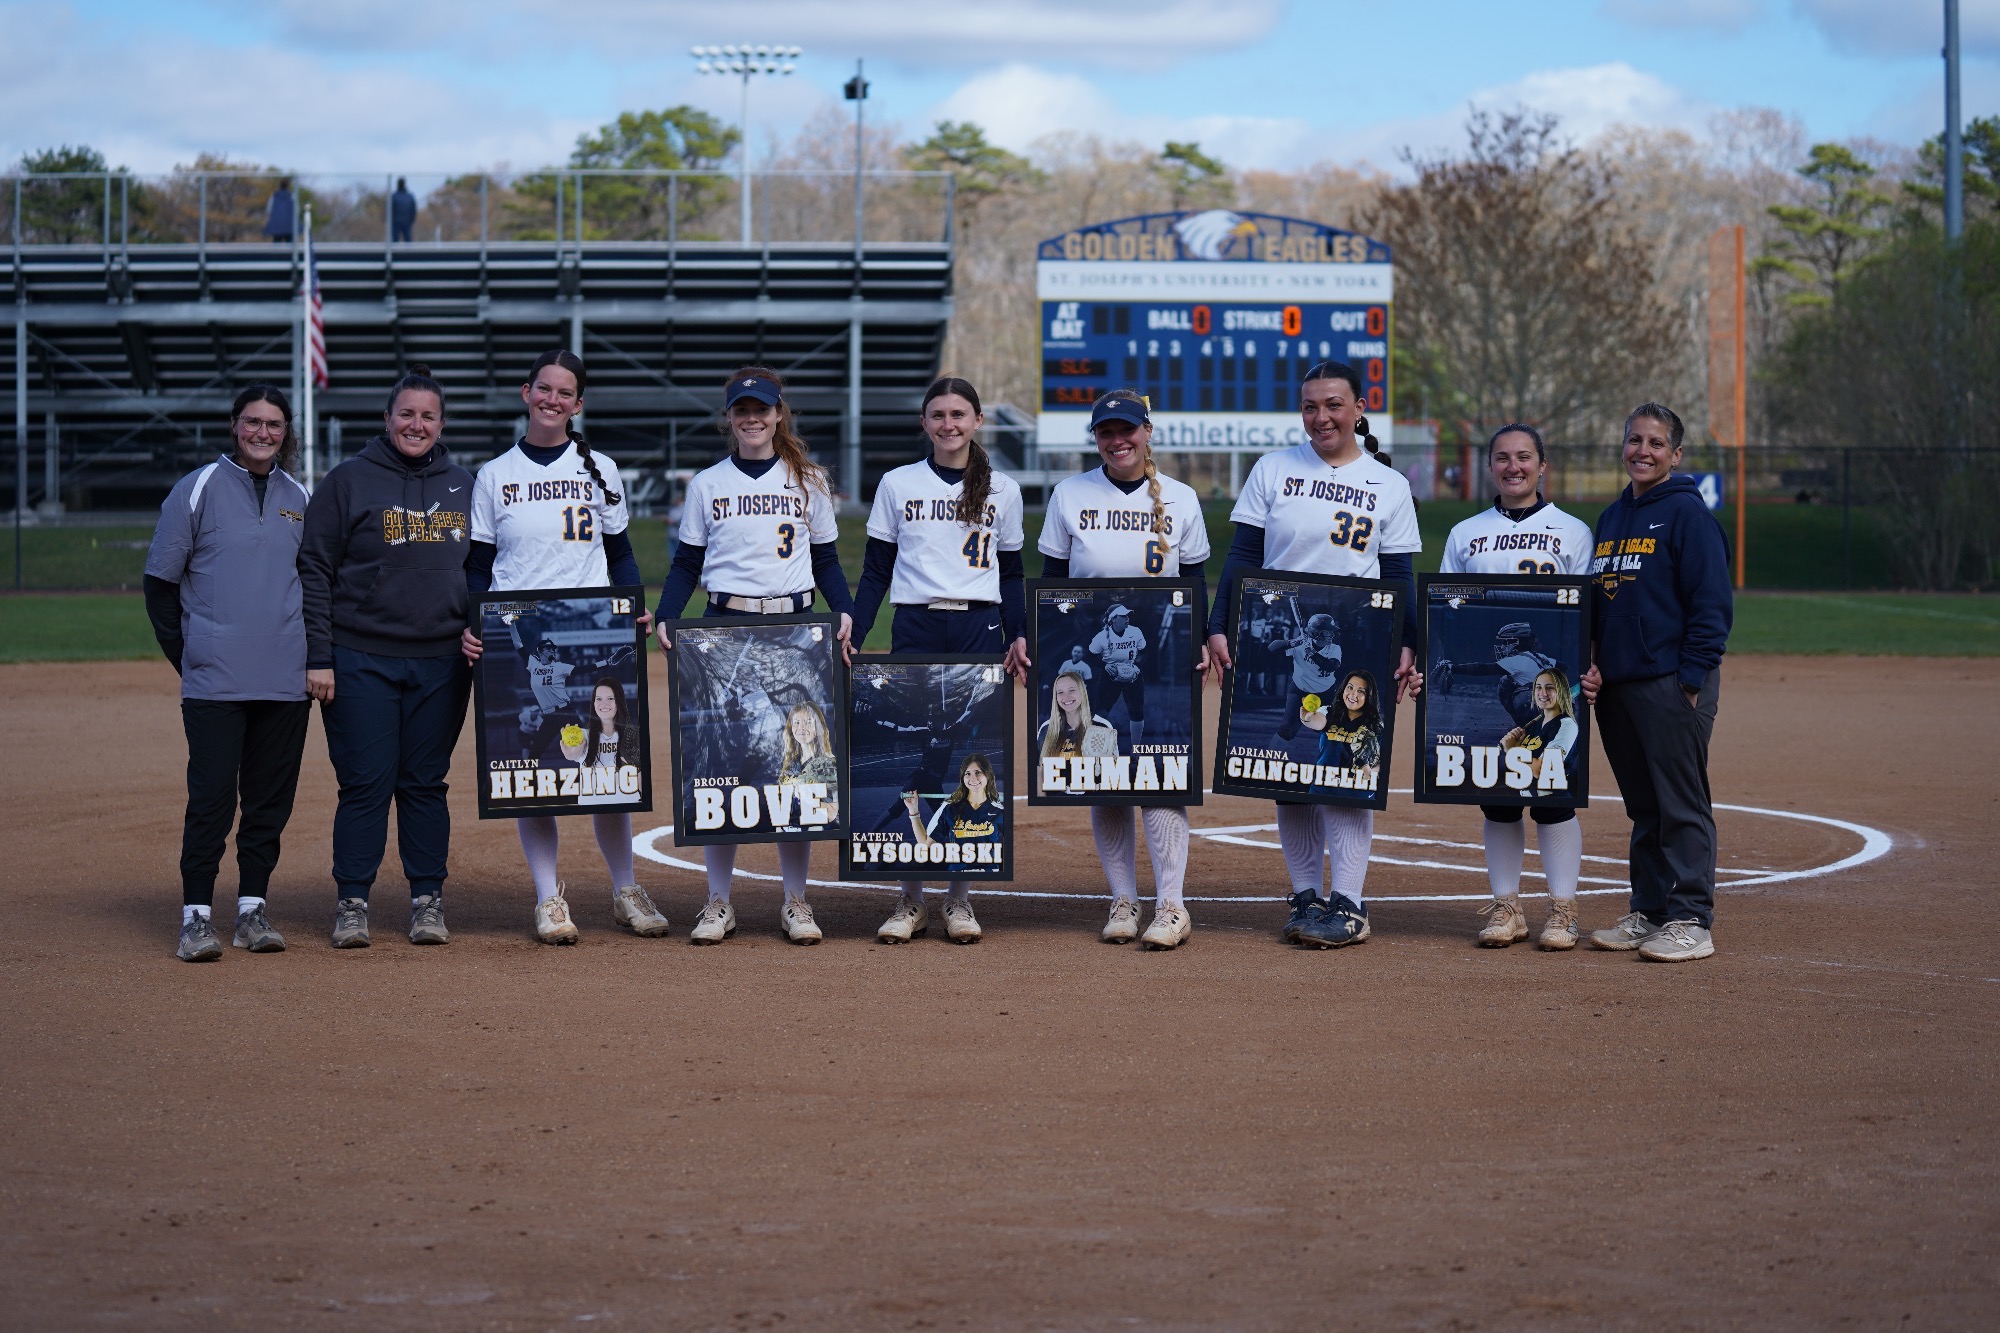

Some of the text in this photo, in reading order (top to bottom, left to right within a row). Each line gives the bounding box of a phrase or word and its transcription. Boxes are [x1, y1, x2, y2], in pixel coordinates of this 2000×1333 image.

[1064, 232, 1368, 262] GOLDEN EAGLES
[1164, 274, 1269, 286] UNIVERSITY
[1290, 276, 1326, 286] NEW
[1335, 276, 1379, 287] YORK
[1057, 302, 1080, 320] AT
[1148, 305, 1211, 335] BALL 0
[1223, 305, 1302, 336] STRIKE 0
[1330, 307, 1385, 336] OUT 0
[1051, 320, 1085, 339] BAT
[1128, 340, 1386, 358] 1 2 3 4 5 6 7 8 9 RUNS
[1368, 358, 1384, 382] 0
[1368, 386, 1384, 410] 0
[502, 480, 593, 506] ST. JOSEPH'S
[1283, 477, 1377, 512] ST. JOSEPH'S
[713, 495, 802, 521] ST. JOSEPH'S
[905, 500, 996, 527] ST. JOS'S
[562, 506, 593, 542] 12
[1079, 510, 1101, 530] ST.
[777, 522, 796, 559] 3
[1330, 510, 1374, 554] 32
[962, 530, 991, 569] 41
[1469, 534, 1561, 557] ST. JOSEPH'S
[1144, 540, 1165, 576] 6
[611, 598, 631, 614] 12
[1172, 591, 1184, 606] 6
[1371, 592, 1394, 609] 32
[1557, 589, 1579, 604] 22
[811, 626, 823, 642] 3
[981, 667, 1000, 683] 41
[1133, 744, 1190, 754] KIMBERLY
[1436, 735, 1464, 744] TONI
[490, 759, 539, 769] CAITLYN
[1229, 746, 1289, 760] ADRIANNA
[1042, 755, 1189, 791] EHMAN
[1436, 745, 1568, 790] BUSA
[490, 765, 640, 799] HERZING
[694, 777, 739, 787] BROOKE
[694, 783, 829, 830] BOVE
[853, 832, 903, 841] KATELYN
[852, 842, 1003, 864] LYSOGORSKI
